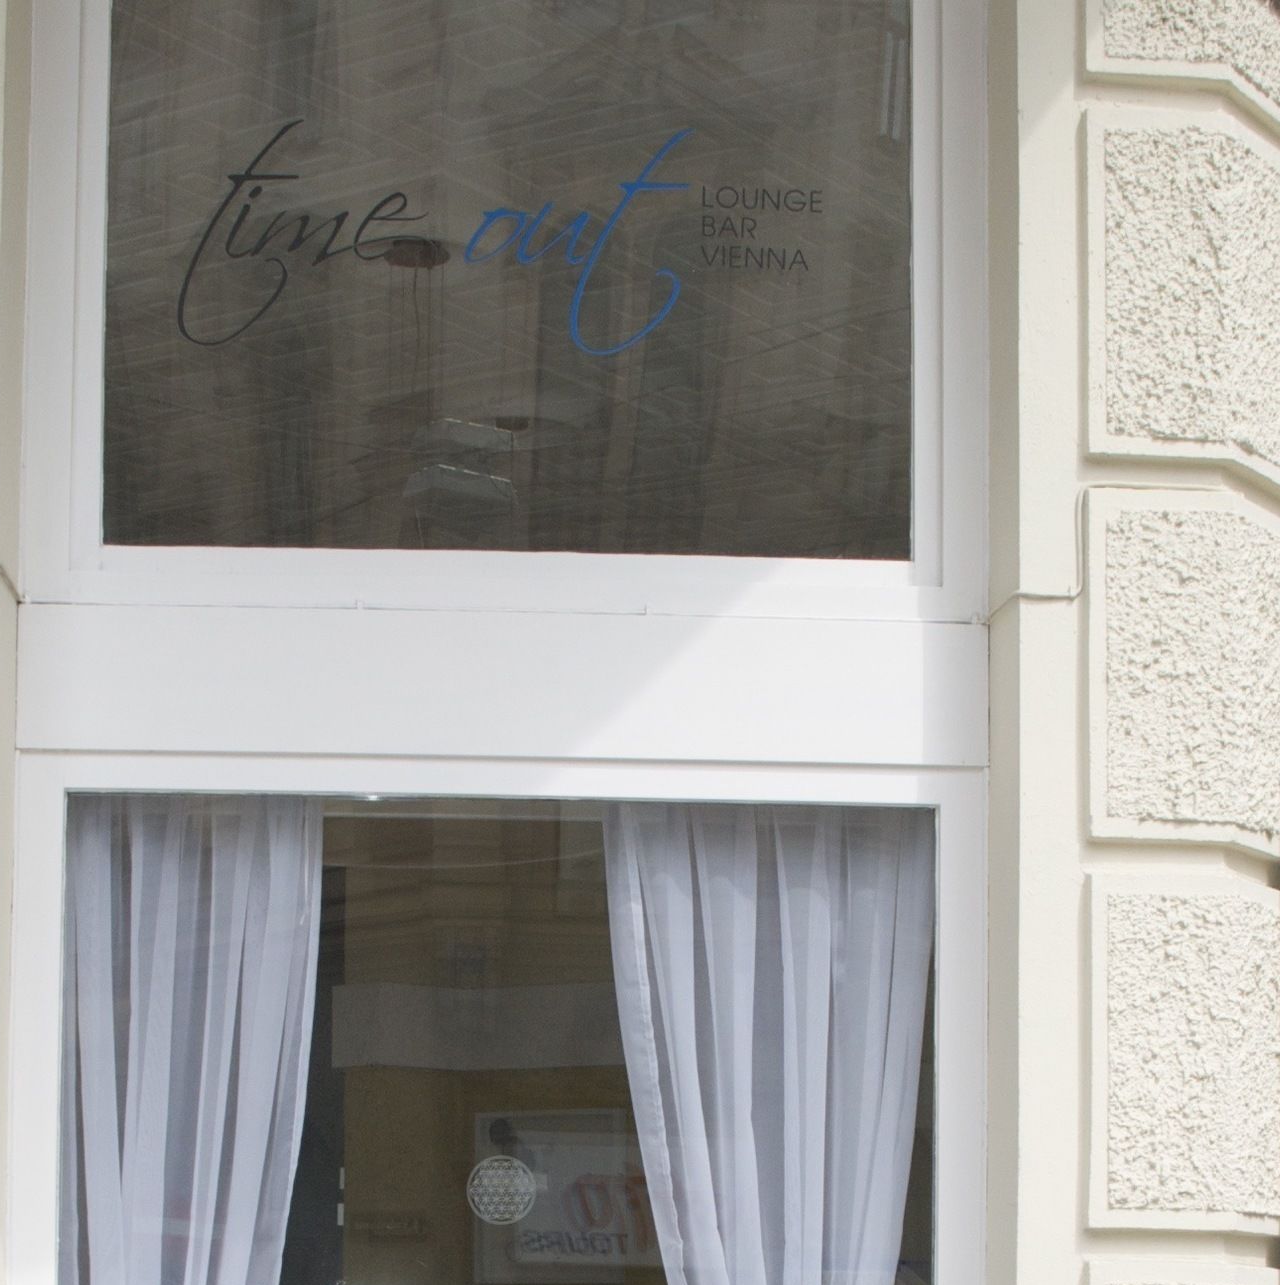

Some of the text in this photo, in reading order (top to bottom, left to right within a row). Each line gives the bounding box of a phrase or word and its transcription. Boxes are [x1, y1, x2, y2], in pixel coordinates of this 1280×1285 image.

[700, 185, 824, 214] LOUNGE
[177, 118, 695, 357] time out
[700, 215, 757, 241] BAR
[700, 245, 809, 272] VIENNA
